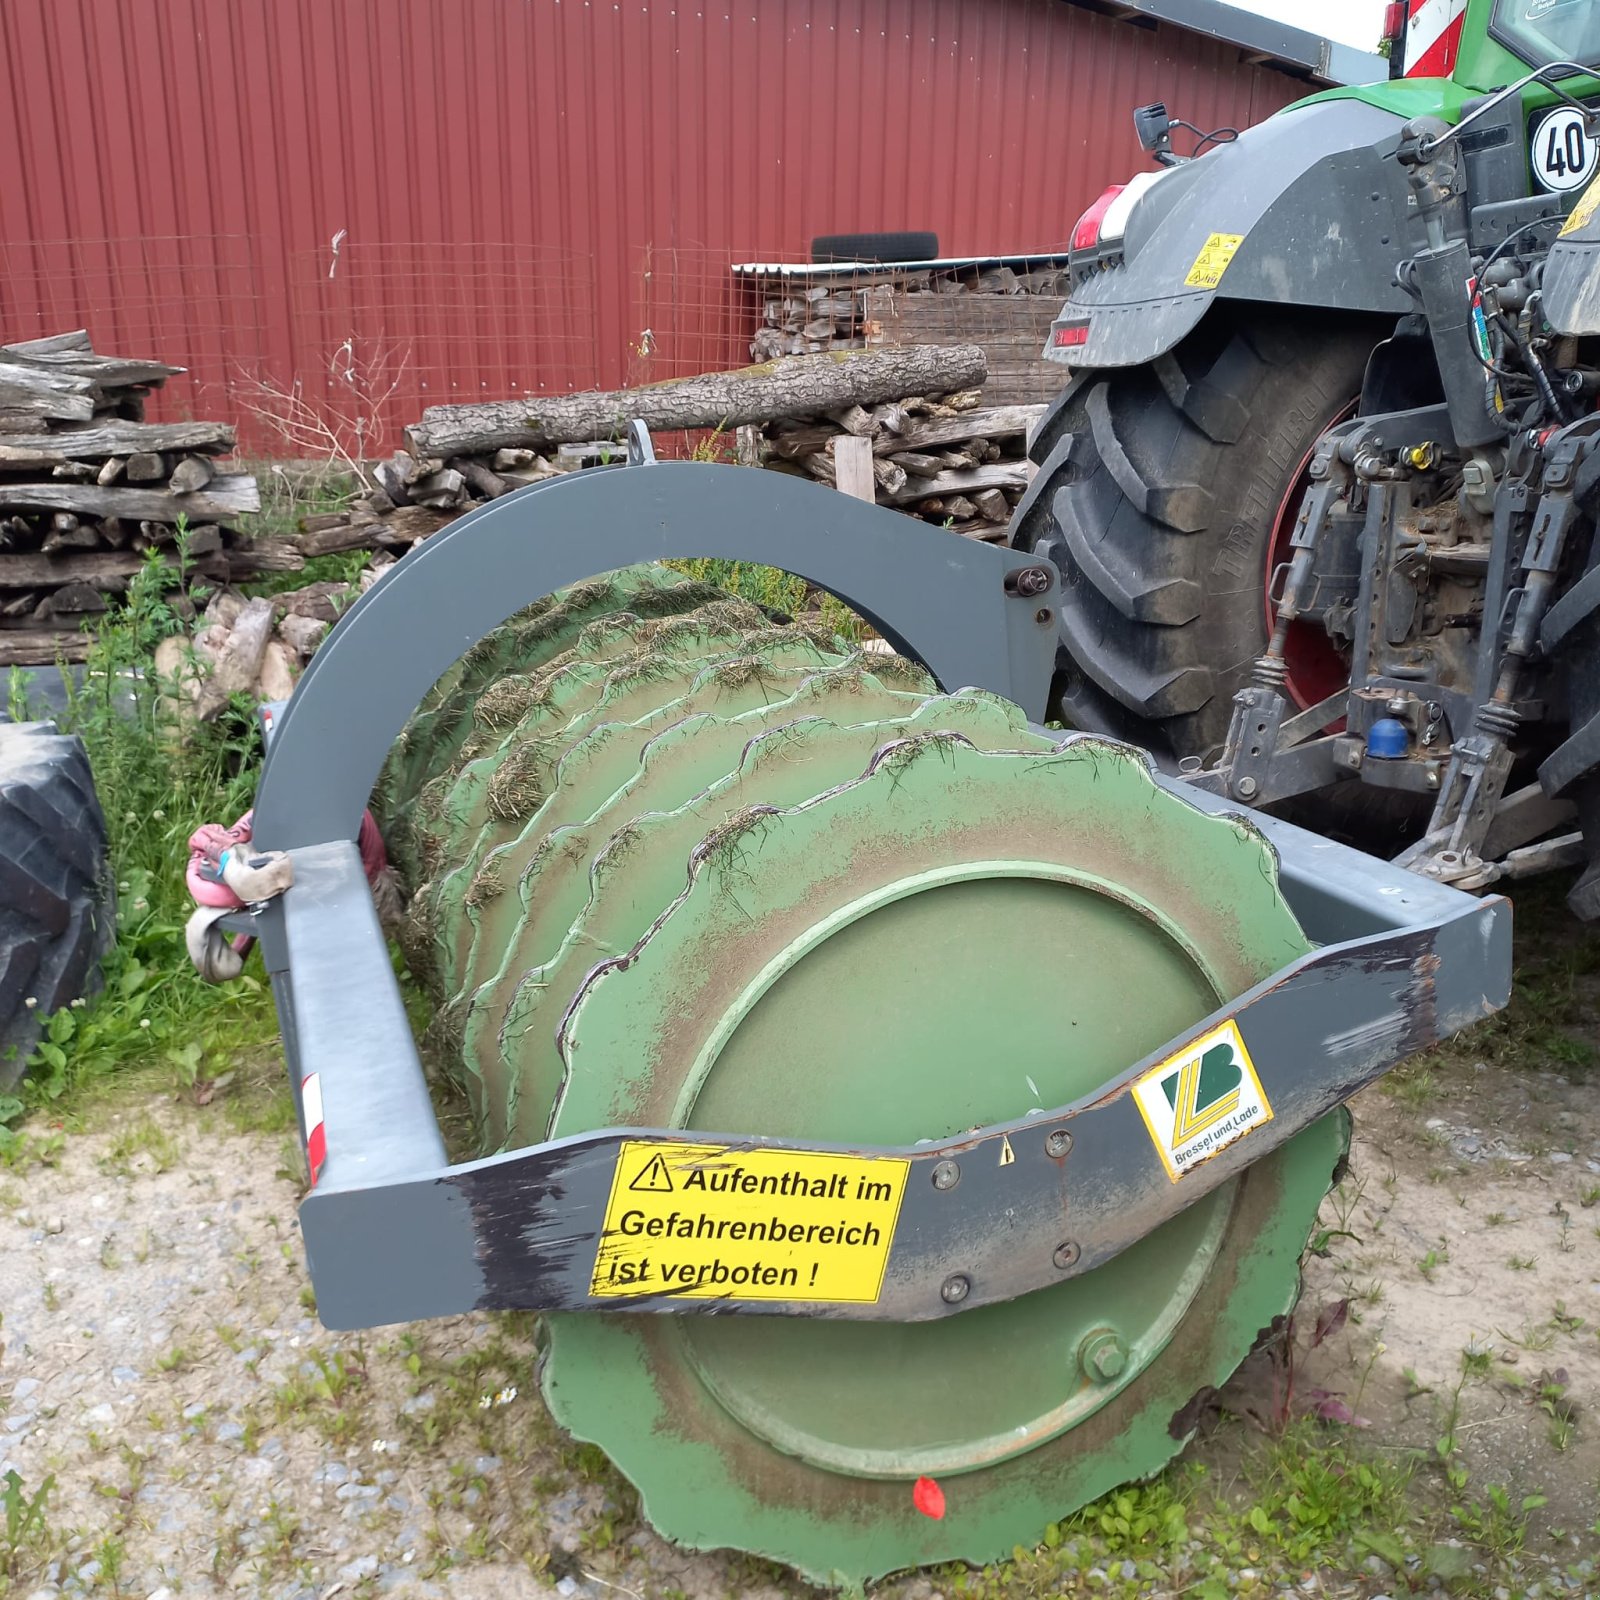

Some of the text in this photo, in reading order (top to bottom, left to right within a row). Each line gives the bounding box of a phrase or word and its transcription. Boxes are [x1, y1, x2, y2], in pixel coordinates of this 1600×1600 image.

[1546, 121, 1585, 177] 40
[1175, 1105, 1258, 1164] Bressel und Lade
[683, 1167, 892, 1201] Aufenthalt im
[619, 1210, 880, 1246] Gefahrenbereich
[608, 1255, 819, 1287] ist verboten !
